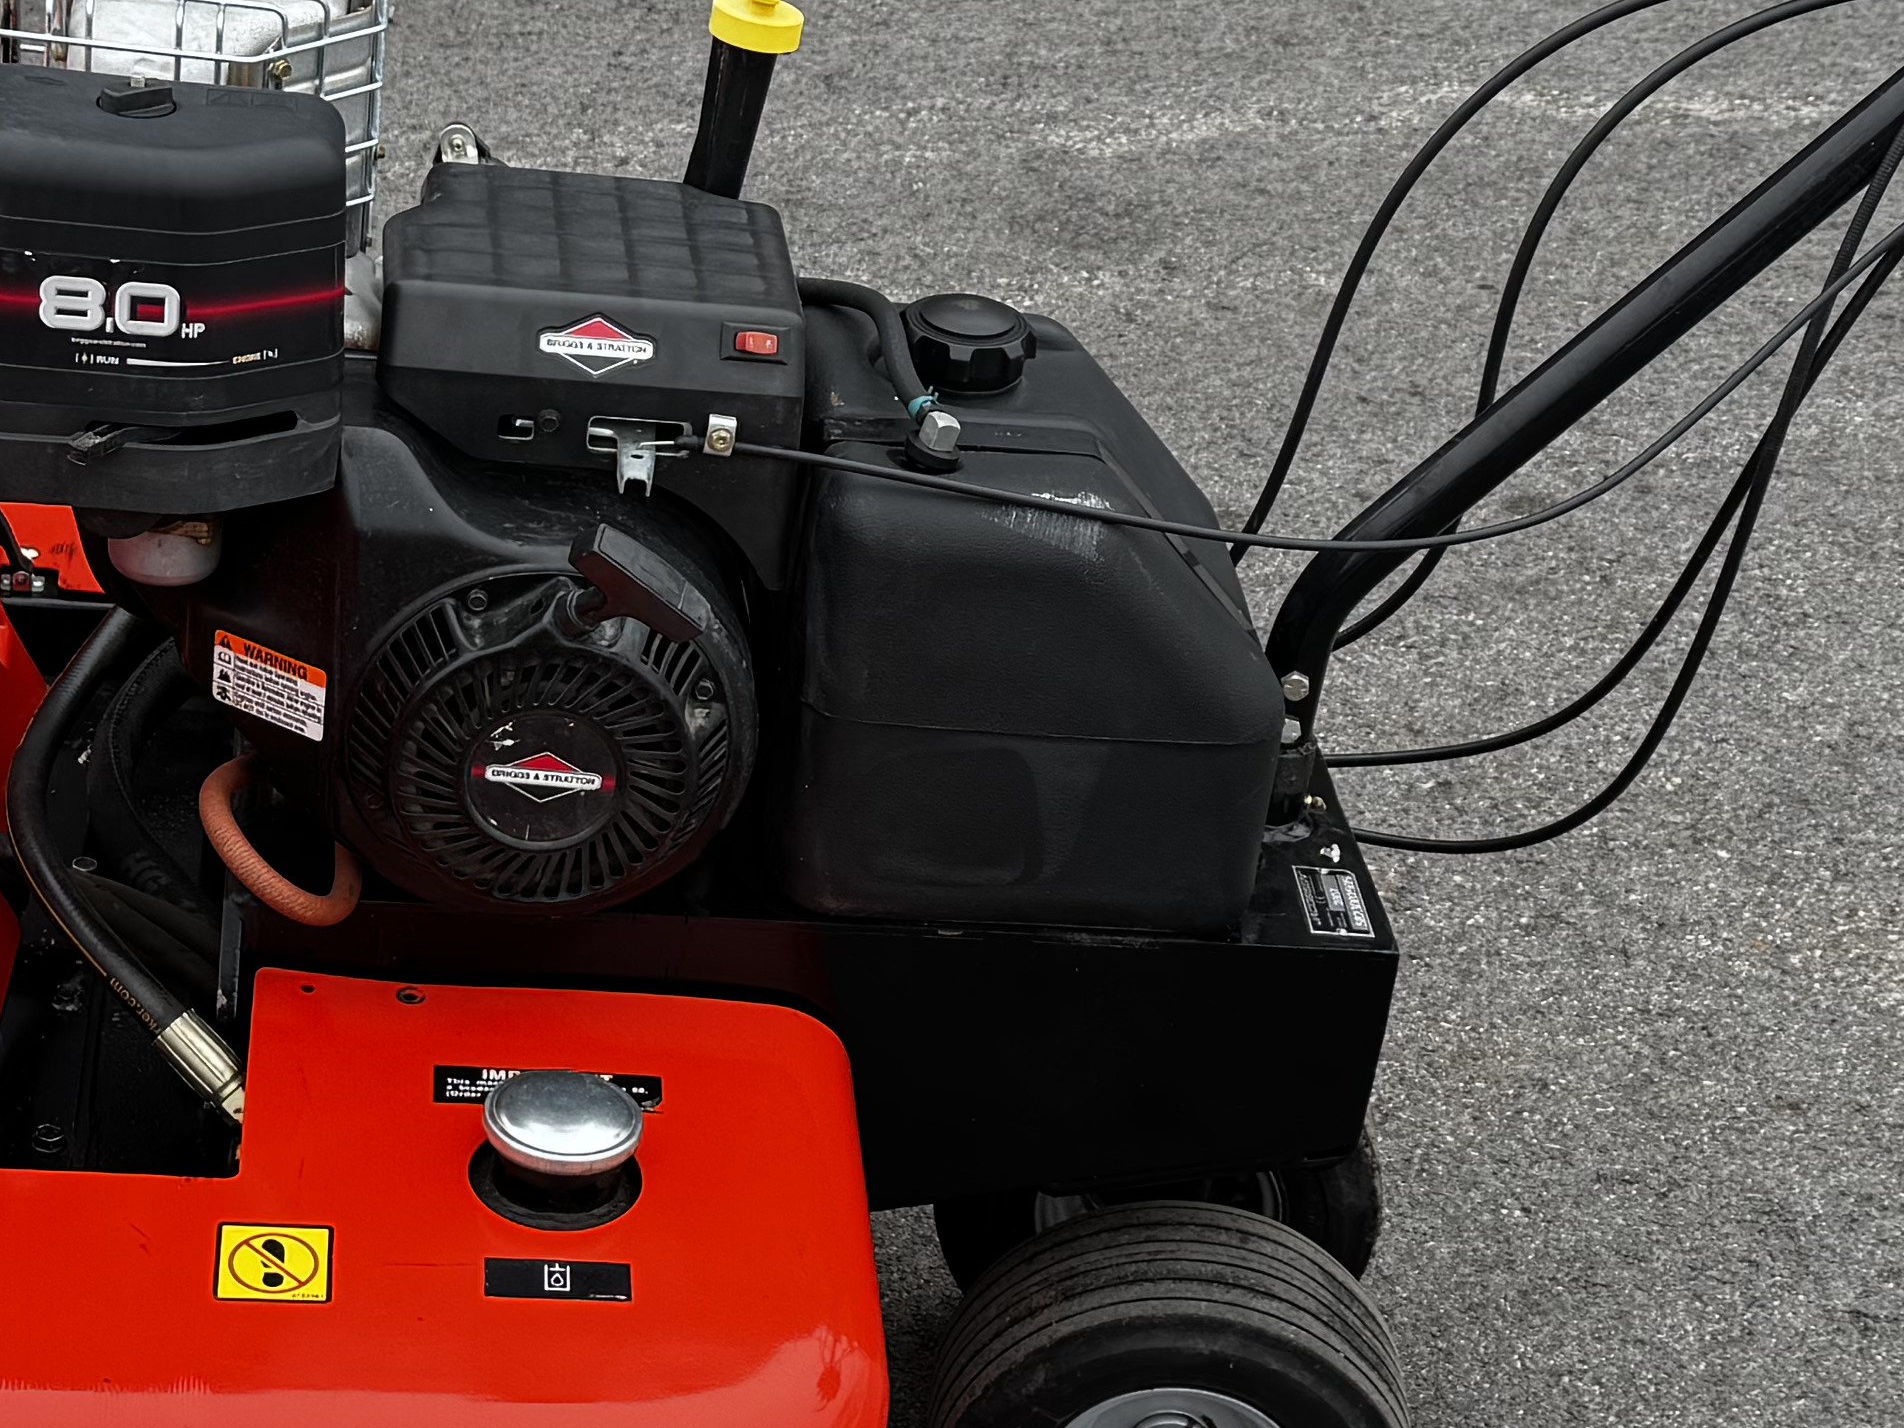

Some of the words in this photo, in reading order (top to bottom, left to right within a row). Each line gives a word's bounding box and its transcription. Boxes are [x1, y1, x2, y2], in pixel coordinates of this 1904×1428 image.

[39, 275, 180, 337] 8.0
[181, 323, 206, 339] HP
[243, 642, 308, 682] WARNING
[542, 773, 596, 785] STRATTON
